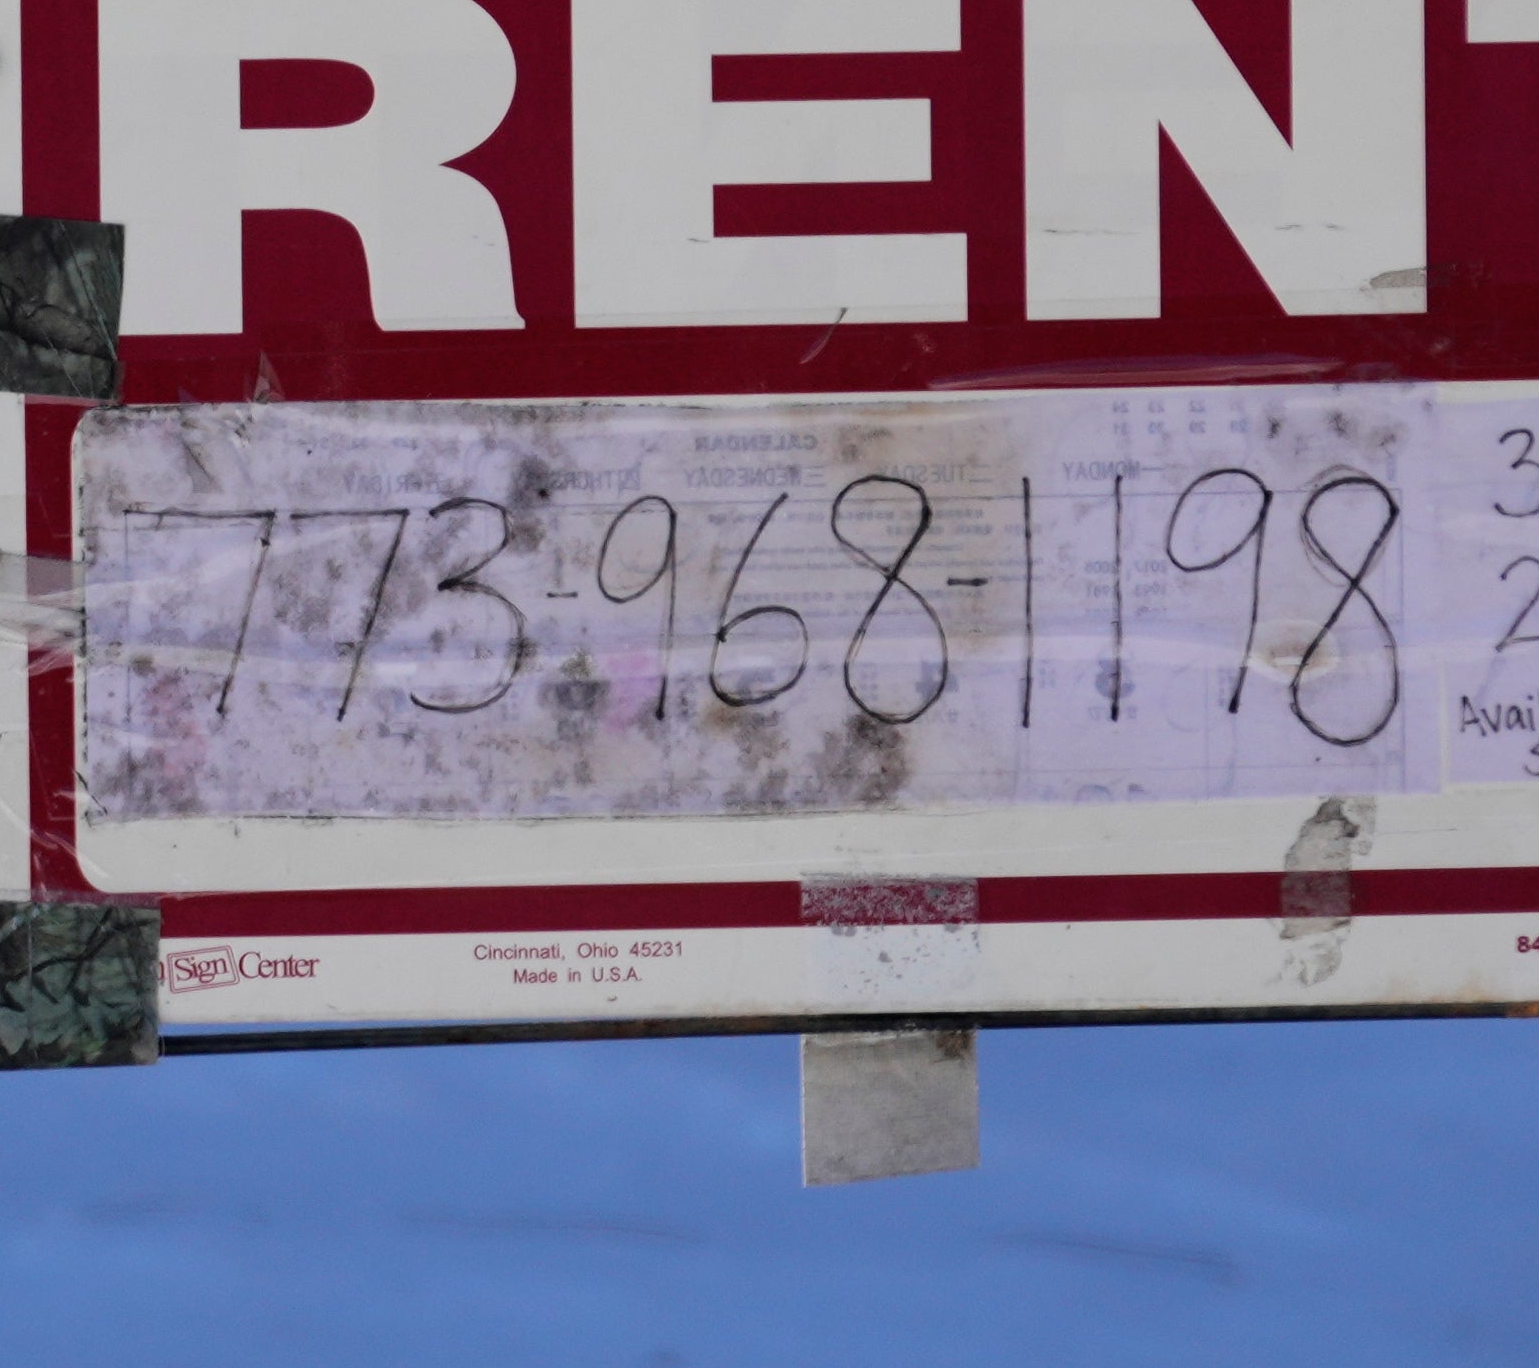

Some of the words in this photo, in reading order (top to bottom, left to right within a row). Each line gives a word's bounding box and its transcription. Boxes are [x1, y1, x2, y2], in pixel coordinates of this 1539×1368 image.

[121, 467, 1400, 747] 773-968-1198
[473, 943, 566, 961] Cincinnati,
[577, 942, 619, 959] Ohio
[629, 941, 684, 958] 45231
[175, 957, 230, 984] Sign
[238, 950, 319, 980] Center
[513, 967, 558, 983] Made
[568, 967, 582, 983] in
[591, 966, 643, 983] U.S.A.
